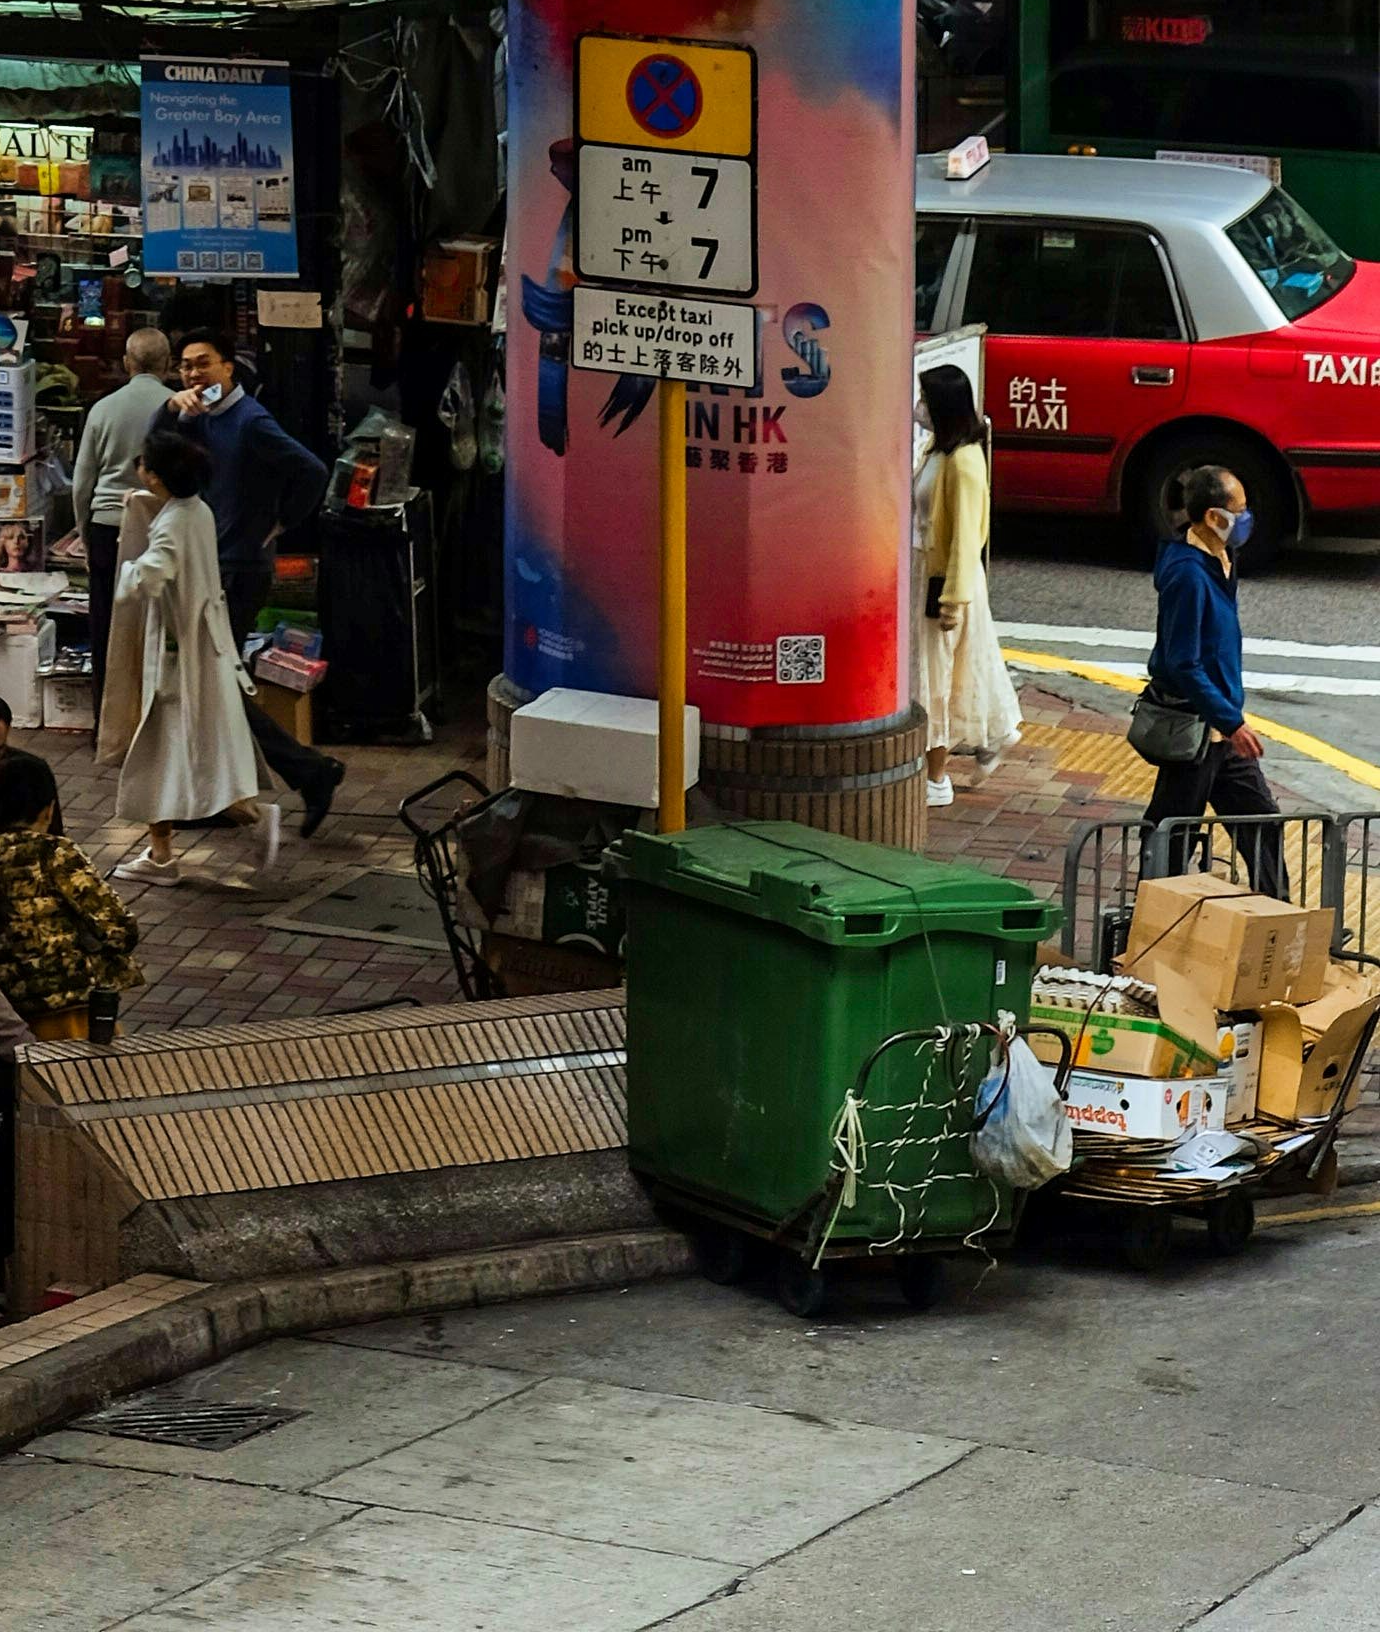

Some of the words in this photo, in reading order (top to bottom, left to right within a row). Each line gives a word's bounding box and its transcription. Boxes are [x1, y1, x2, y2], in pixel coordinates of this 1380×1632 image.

[149, 91, 217, 108] Navigating
[219, 93, 238, 106] the
[155, 108, 210, 123] Greater
[214, 109, 241, 126] Bay
[246, 111, 282, 125] Area
[612, 178, 662, 205] 上午
[621, 156, 652, 172] am
[690, 167, 719, 210] 7
[612, 247, 663, 274] 下午
[621, 225, 652, 246] pm
[690, 237, 719, 280] 7
[615, 298, 676, 323] Except
[679, 305, 712, 327] taxi
[592, 317, 628, 338] pick
[634, 323, 703, 349] up/drop
[709, 331, 734, 349] off
[582, 339, 744, 381] 的士上落客除外
[1303, 352, 1368, 386] TAXI
[1009, 376, 1067, 405] 的士
[733, 405, 788, 445] HK
[1009, 403, 1069, 431] TAXI
[584, 876, 599, 930] APPLE
[597, 886, 610, 925] FUJI
